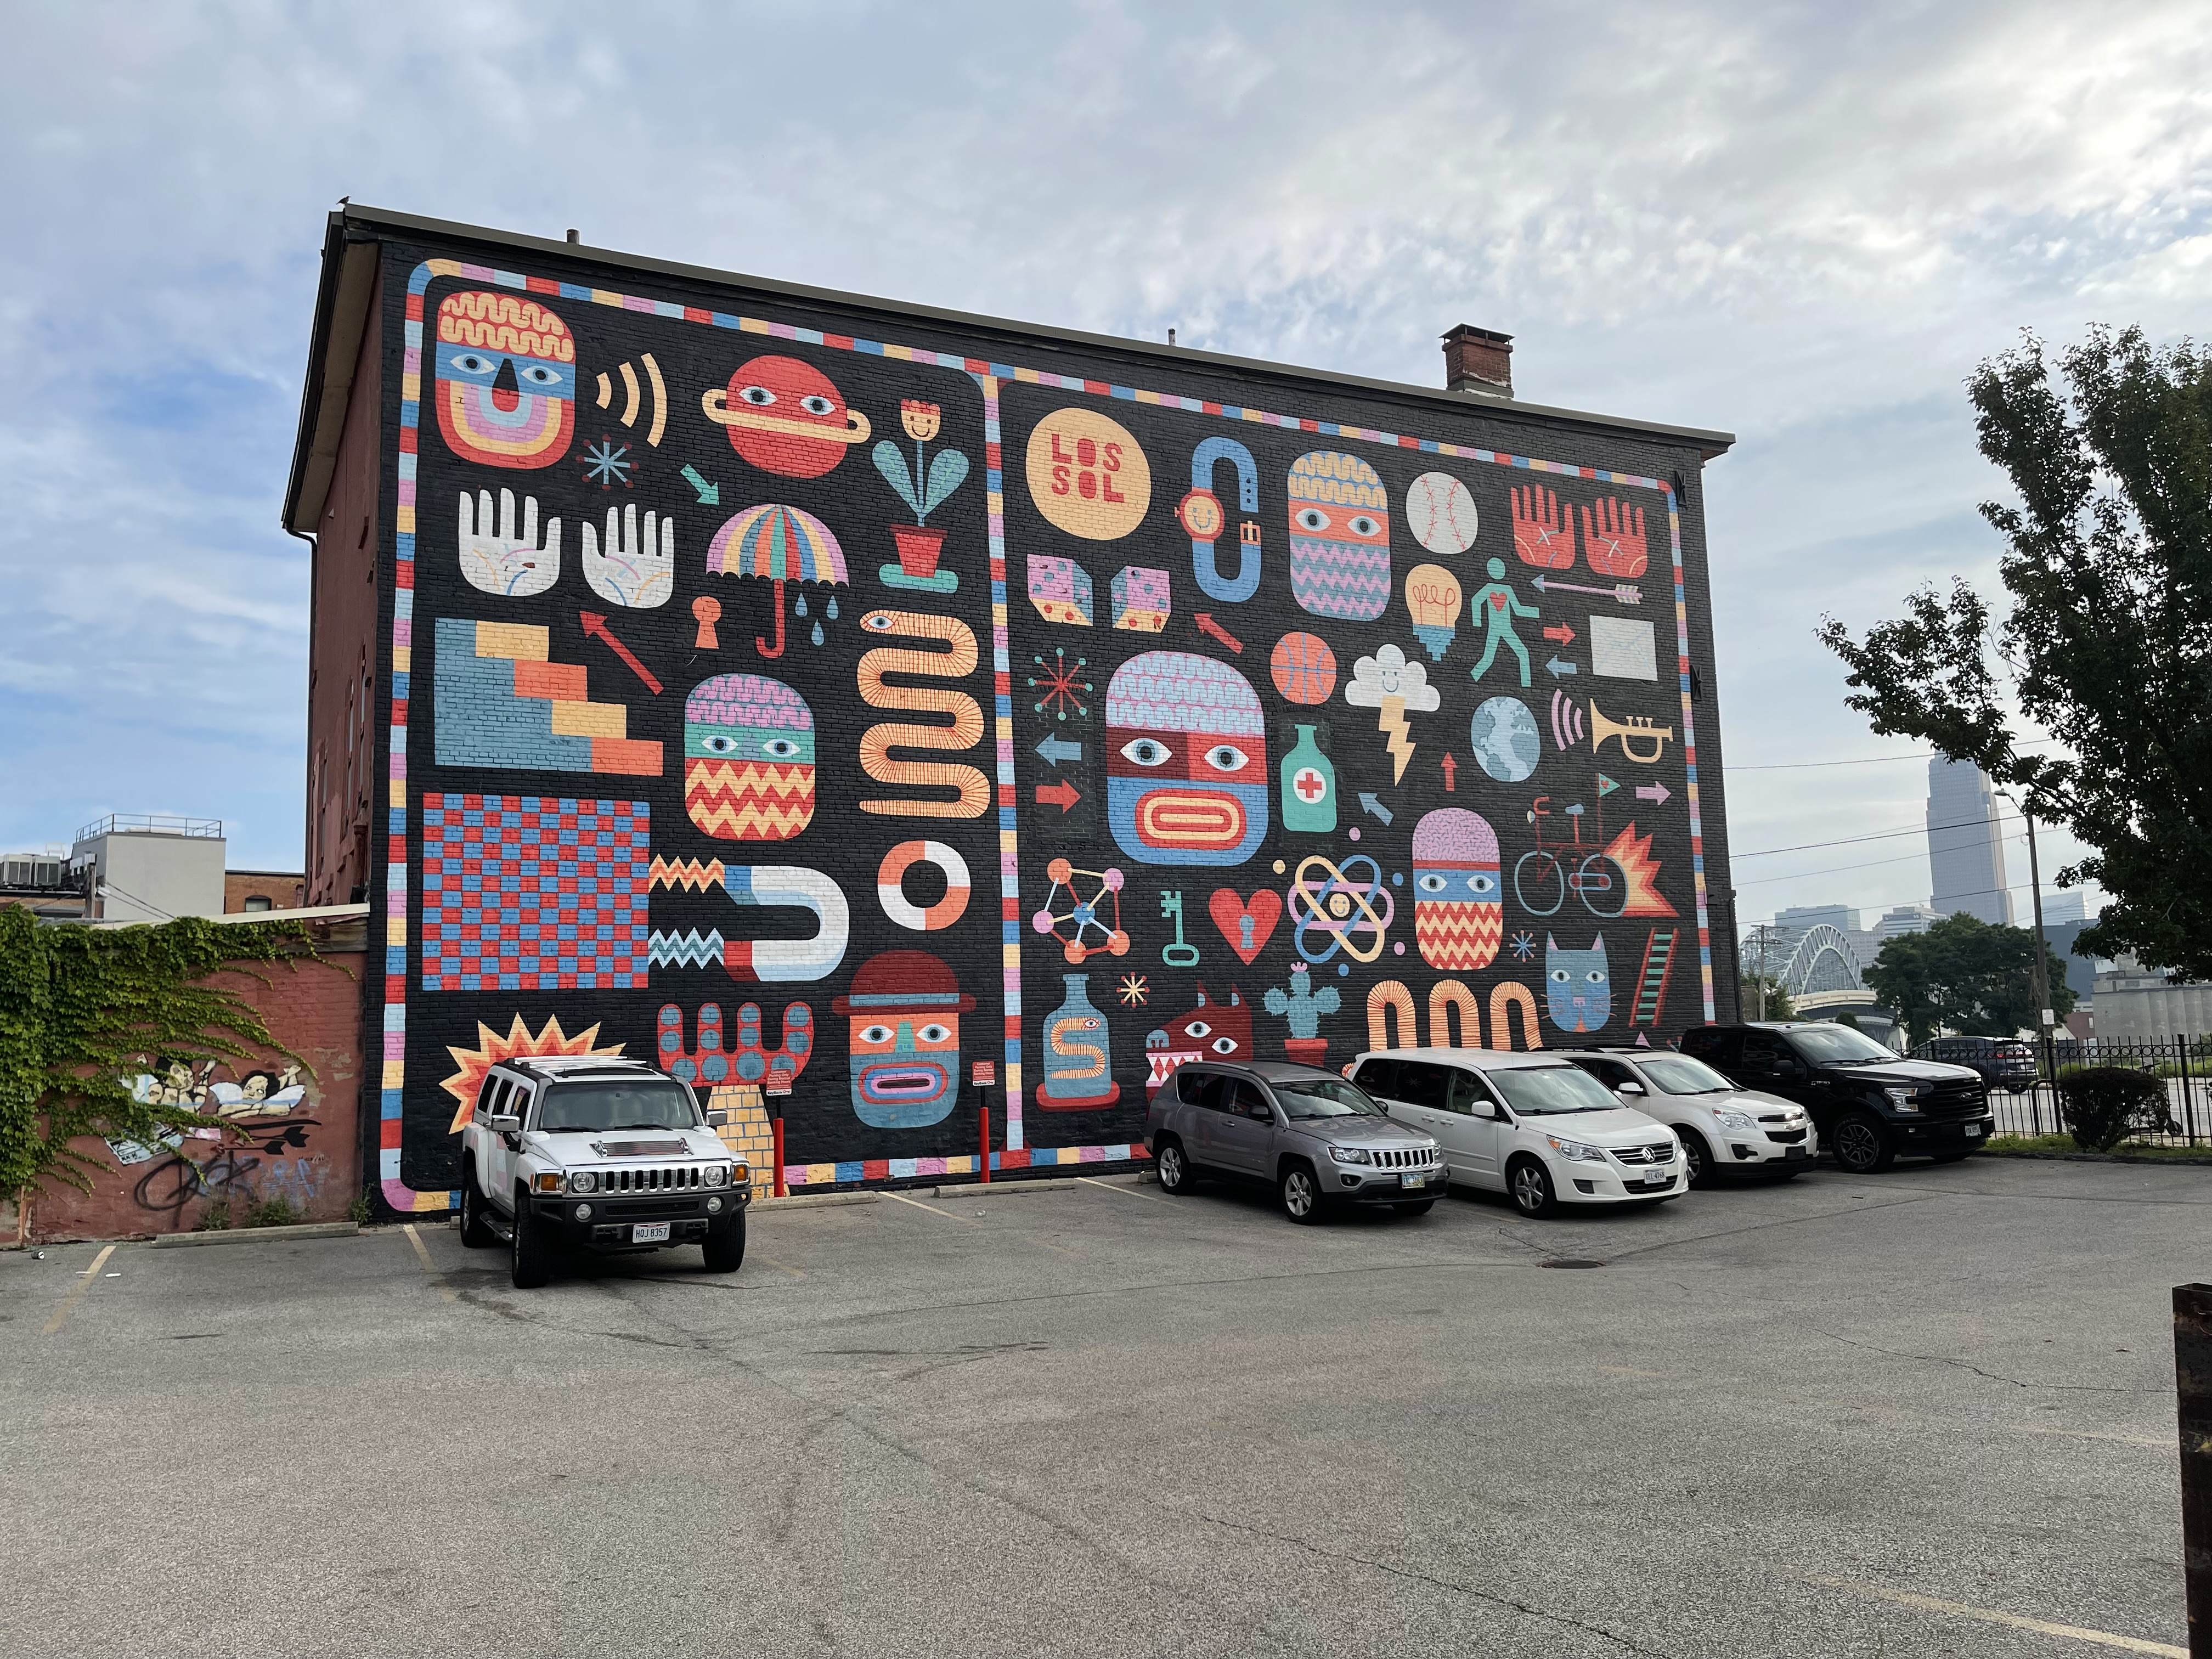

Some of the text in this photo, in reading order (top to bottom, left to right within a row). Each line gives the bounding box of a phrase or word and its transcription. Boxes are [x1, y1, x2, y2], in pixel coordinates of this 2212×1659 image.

[1051, 433, 1122, 472] LOS
[1051, 465, 1124, 503] SOL
[636, 1227, 668, 1238] HQJ 8357
